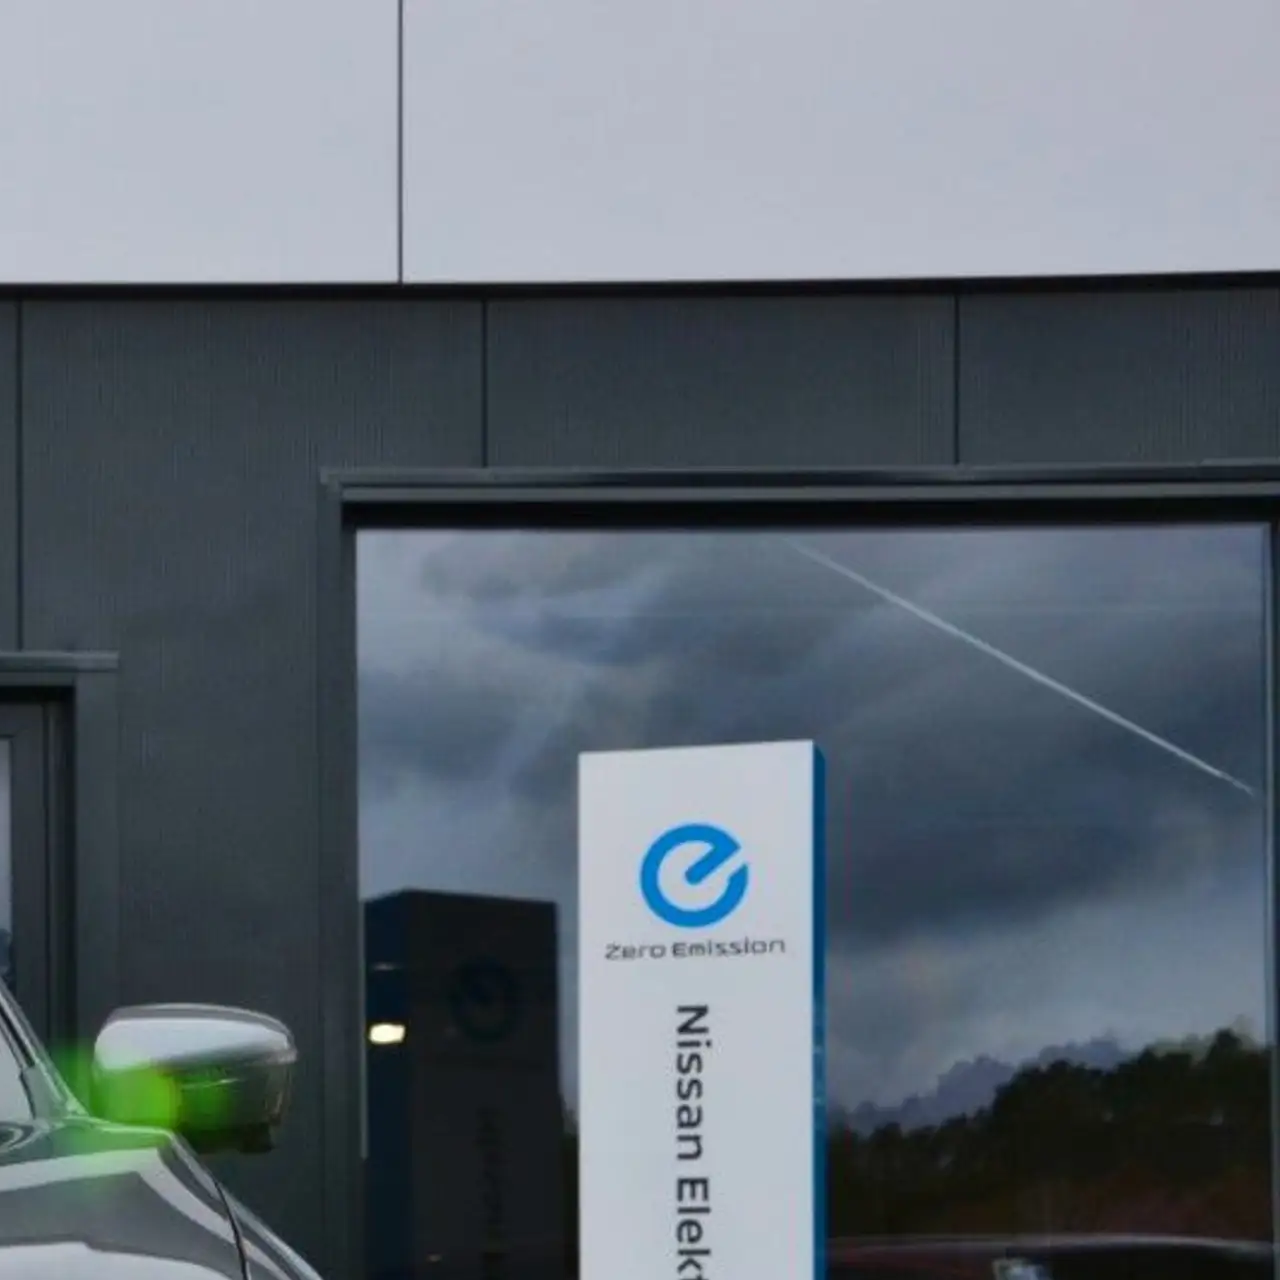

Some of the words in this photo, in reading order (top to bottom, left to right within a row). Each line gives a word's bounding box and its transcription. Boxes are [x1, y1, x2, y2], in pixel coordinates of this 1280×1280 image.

[604, 942, 666, 960] Zero
[671, 937, 786, 958] Emission
[676, 1004, 712, 1161] Nissan
